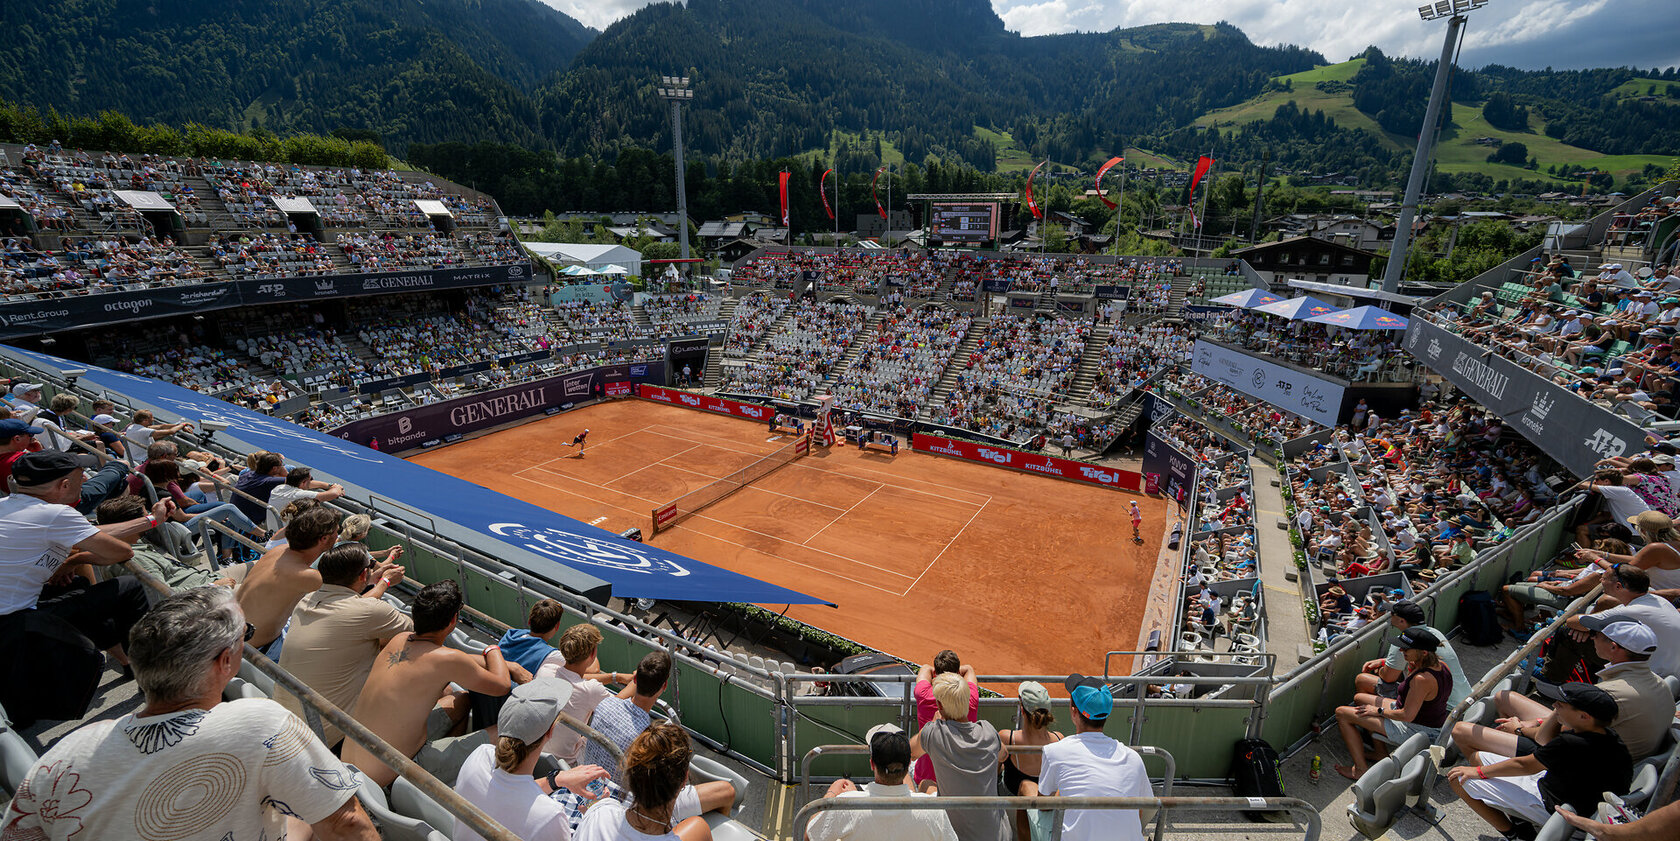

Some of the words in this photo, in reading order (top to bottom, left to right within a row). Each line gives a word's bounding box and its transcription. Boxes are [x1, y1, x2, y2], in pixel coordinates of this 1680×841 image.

[380, 275, 434, 288] GENERALI
[453, 273, 491, 281] MATRIX
[257, 283, 285, 294] ATP
[103, 298, 153, 313] octagon
[9, 309, 69, 322] Rent.Group
[1462, 355, 1510, 400] GENERALI
[450, 387, 547, 427] GENERALI
[1520, 413, 1544, 436] kronehit
[388, 430, 426, 446] bitpanda
[1583, 427, 1627, 459] ATP
[929, 445, 963, 457] KITZBÜHEL
[1025, 462, 1063, 476] KITZBÜHEL
